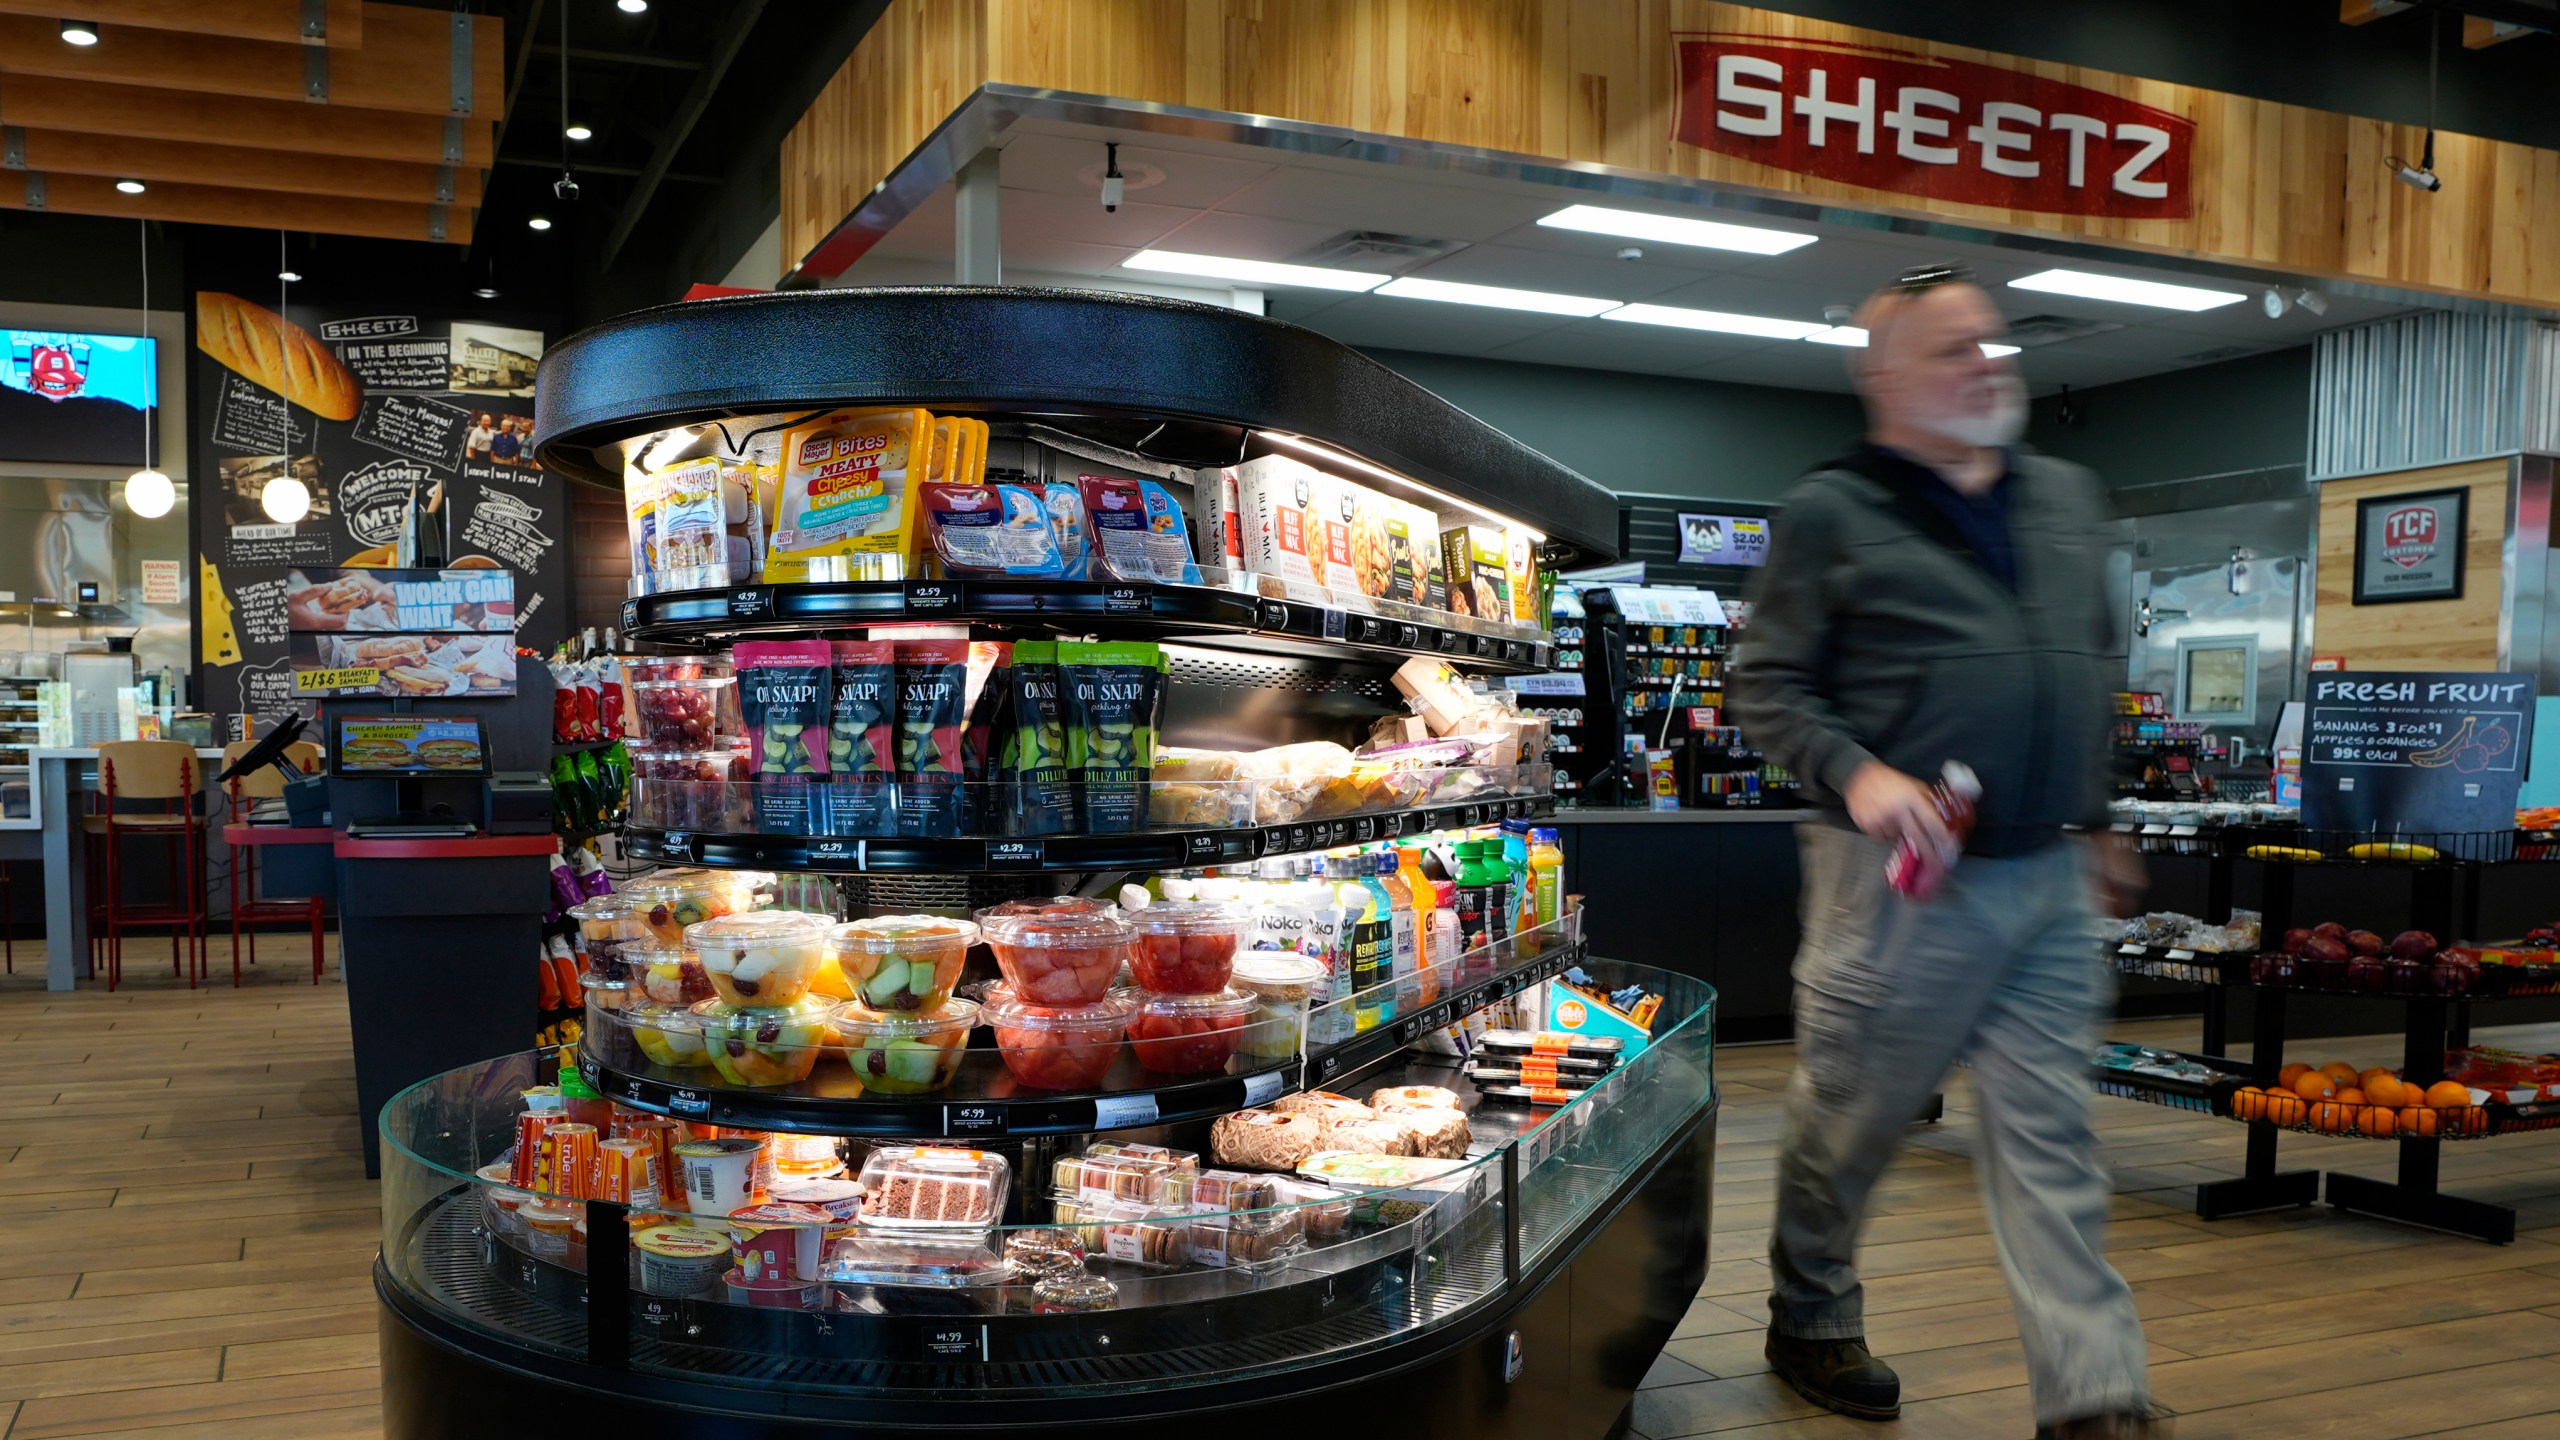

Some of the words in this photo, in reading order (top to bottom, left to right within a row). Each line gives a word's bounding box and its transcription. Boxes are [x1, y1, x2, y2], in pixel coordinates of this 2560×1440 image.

[1715, 54, 2170, 198] SHEETZ
[327, 319, 412, 337] SHEETZ
[348, 346, 360, 359] IN
[364, 345, 387, 359] THE
[388, 342, 449, 358] BEGINNING
[385, 397, 415, 417] FAMILY
[416, 406, 453, 428] MATTERS!
[805, 440, 830, 453] Oscar
[837, 434, 886, 457] Bites
[803, 447, 830, 461] Mayer
[819, 453, 881, 477] MEATY
[344, 468, 422, 497] WELCOME
[657, 470, 717, 498] LUNCHABLES
[817, 470, 869, 493] Cheesy
[818, 484, 873, 507] Crunchy
[1208, 499, 1217, 524] BUFF
[1258, 492, 1267, 524] BUFF
[1283, 510, 1298, 525] BUFF
[2389, 511, 2433, 538] TCF
[776, 530, 791, 540] 100%
[1331, 525, 1345, 539] BUFF
[1732, 533, 1764, 545] $2.00
[1212, 541, 1221, 567] MAC
[1262, 535, 1273, 566] MAC
[1454, 533, 1466, 577] Panera
[2383, 545, 2434, 556] CUSTOMER
[143, 563, 178, 571] WARNING
[1445, 553, 1453, 583] CHEESE
[2384, 574, 2400, 582] OUR
[2401, 571, 2433, 580] MISSION
[235, 587, 247, 595] WE
[247, 581, 273, 594] OFFER
[239, 588, 279, 602] TOPPINGS
[395, 582, 464, 605] WORK
[464, 578, 512, 602] CAN
[916, 587, 941, 597] $2.59
[1113, 589, 1134, 599] $2.59
[737, 591, 757, 601] $3.99
[242, 601, 255, 609] WE
[256, 599, 274, 608] CAN
[514, 611, 530, 628] THE
[525, 592, 544, 614] LOVE
[243, 607, 278, 619] COUNT,
[397, 604, 453, 629] WAIT
[246, 617, 265, 627] CAN
[247, 625, 274, 635] MEAL
[254, 635, 266, 643] AS
[268, 635, 285, 644] YOU
[251, 673, 263, 681] WE
[265, 673, 290, 681] WANT
[301, 671, 335, 688] 2/$6
[339, 669, 376, 678] BREAKFAST
[250, 681, 266, 690] OUR
[339, 677, 369, 685] SAMMIEZ
[250, 690, 259, 699] TO
[261, 690, 277, 699] FEEL
[277, 690, 288, 699] THE
[339, 686, 355, 694] 5AM
[359, 685, 376, 694] 10AM
[756, 686, 771, 703] OH
[772, 685, 817, 703] SNAP!
[838, 683, 879, 701] SNAP!
[905, 683, 950, 701] SNAP!
[1024, 681, 1041, 699] OH
[1077, 683, 1095, 700] OH
[1100, 684, 1143, 701] SNAP!
[2429, 683, 2526, 704] FRUIT
[2313, 721, 2379, 733] BANANAS
[2385, 721, 2396, 733] 3
[2399, 723, 2427, 734] FOR
[2428, 722, 2442, 735] $1
[2312, 734, 2365, 746] APPLES
[2332, 747, 2361, 759] 99¢
[1037, 769, 1061, 783] DILLY
[1084, 770, 1112, 782] DILLY
[1116, 770, 1139, 782] BITE
[820, 842, 843, 853] $2.39
[1000, 843, 1024, 853] $2.39
[1261, 914, 1303, 931] Noka
[1425, 912, 1433, 932] G
[961, 1108, 985, 1119] $5.99
[1113, 1238, 1135, 1247] Poppies
[936, 1331, 962, 1342] $4.99
